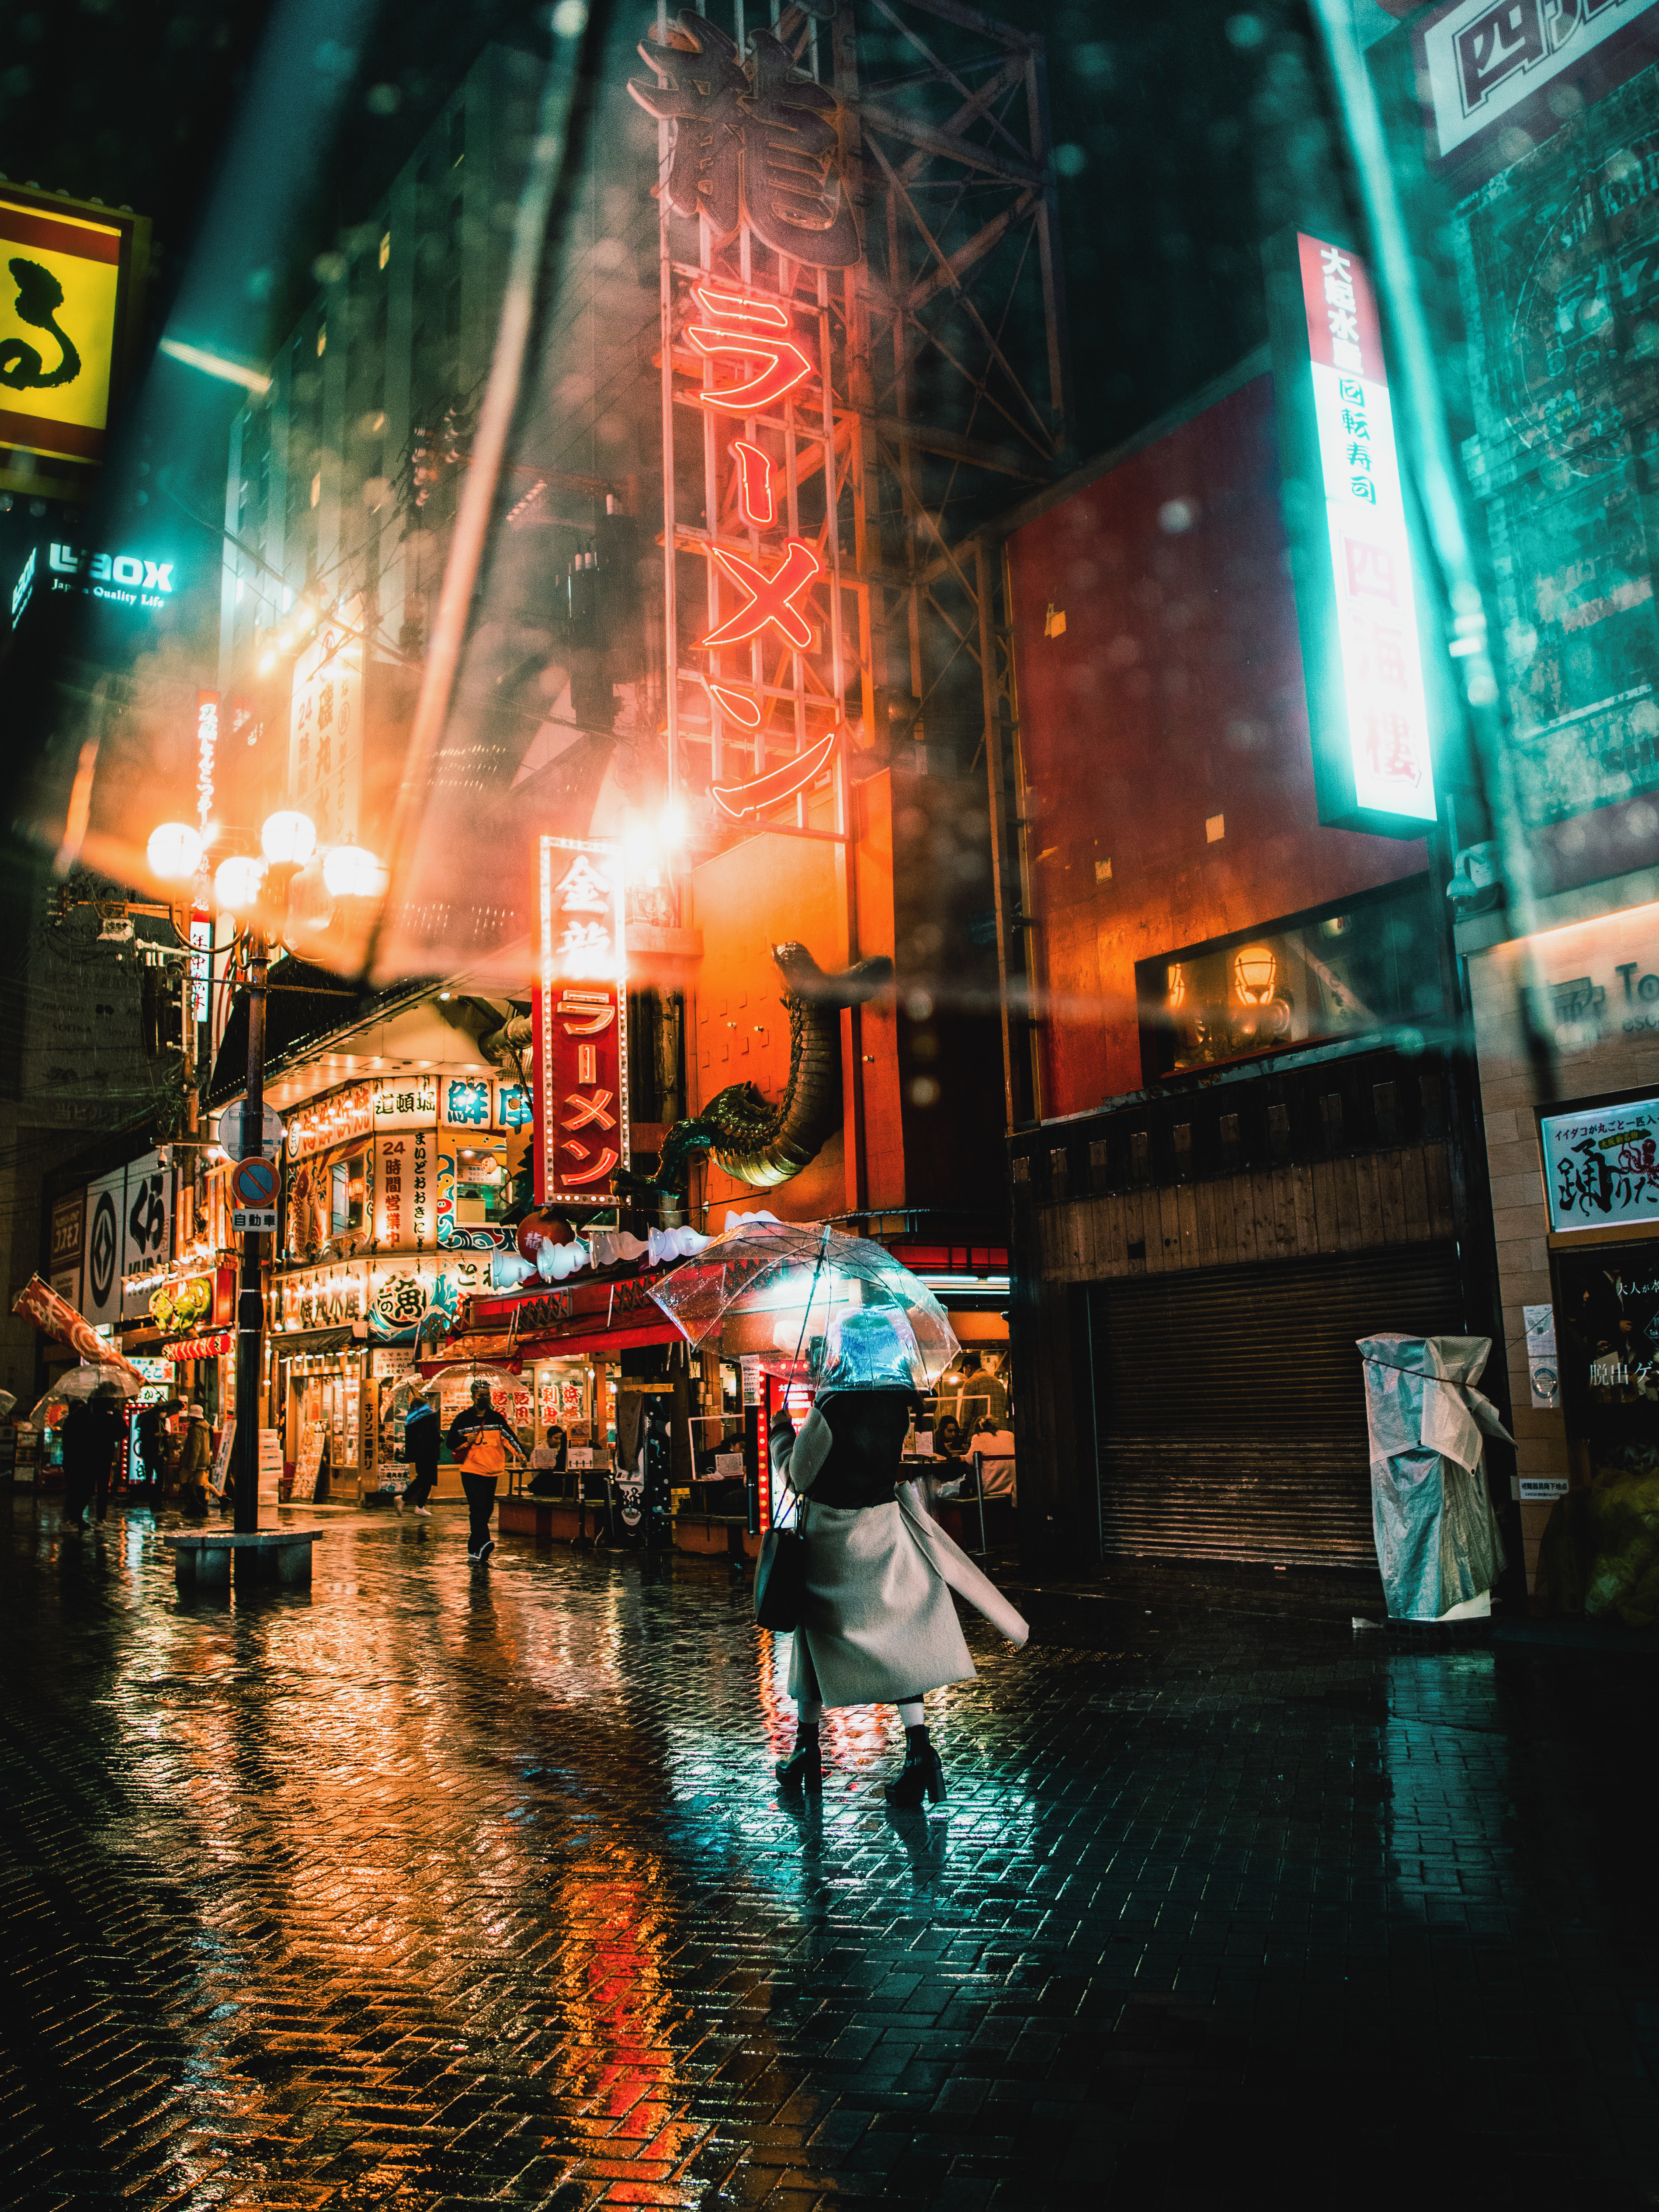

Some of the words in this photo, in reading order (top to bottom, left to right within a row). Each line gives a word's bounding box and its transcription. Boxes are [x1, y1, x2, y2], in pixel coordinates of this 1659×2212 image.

[1320, 247, 1365, 375] 大起水産
[1339, 376, 1377, 505] 回転寿司
[52, 579, 89, 594] Japn
[93, 586, 137, 605] Quality
[141, 594, 164, 608] Life
[555, 854, 619, 1185] 金龍ラーメン
[375, 1092, 435, 1114] 道頓堀
[382, 1141, 406, 1248] 24時間営業中
[414, 1132, 427, 1234] まいどおおきに
[234, 1213, 275, 1227] 自動車
[524, 1230, 542, 1250] 龍
[364, 1403, 374, 1470] キリン一番搾り
[542, 1386, 558, 1424] 刺身
